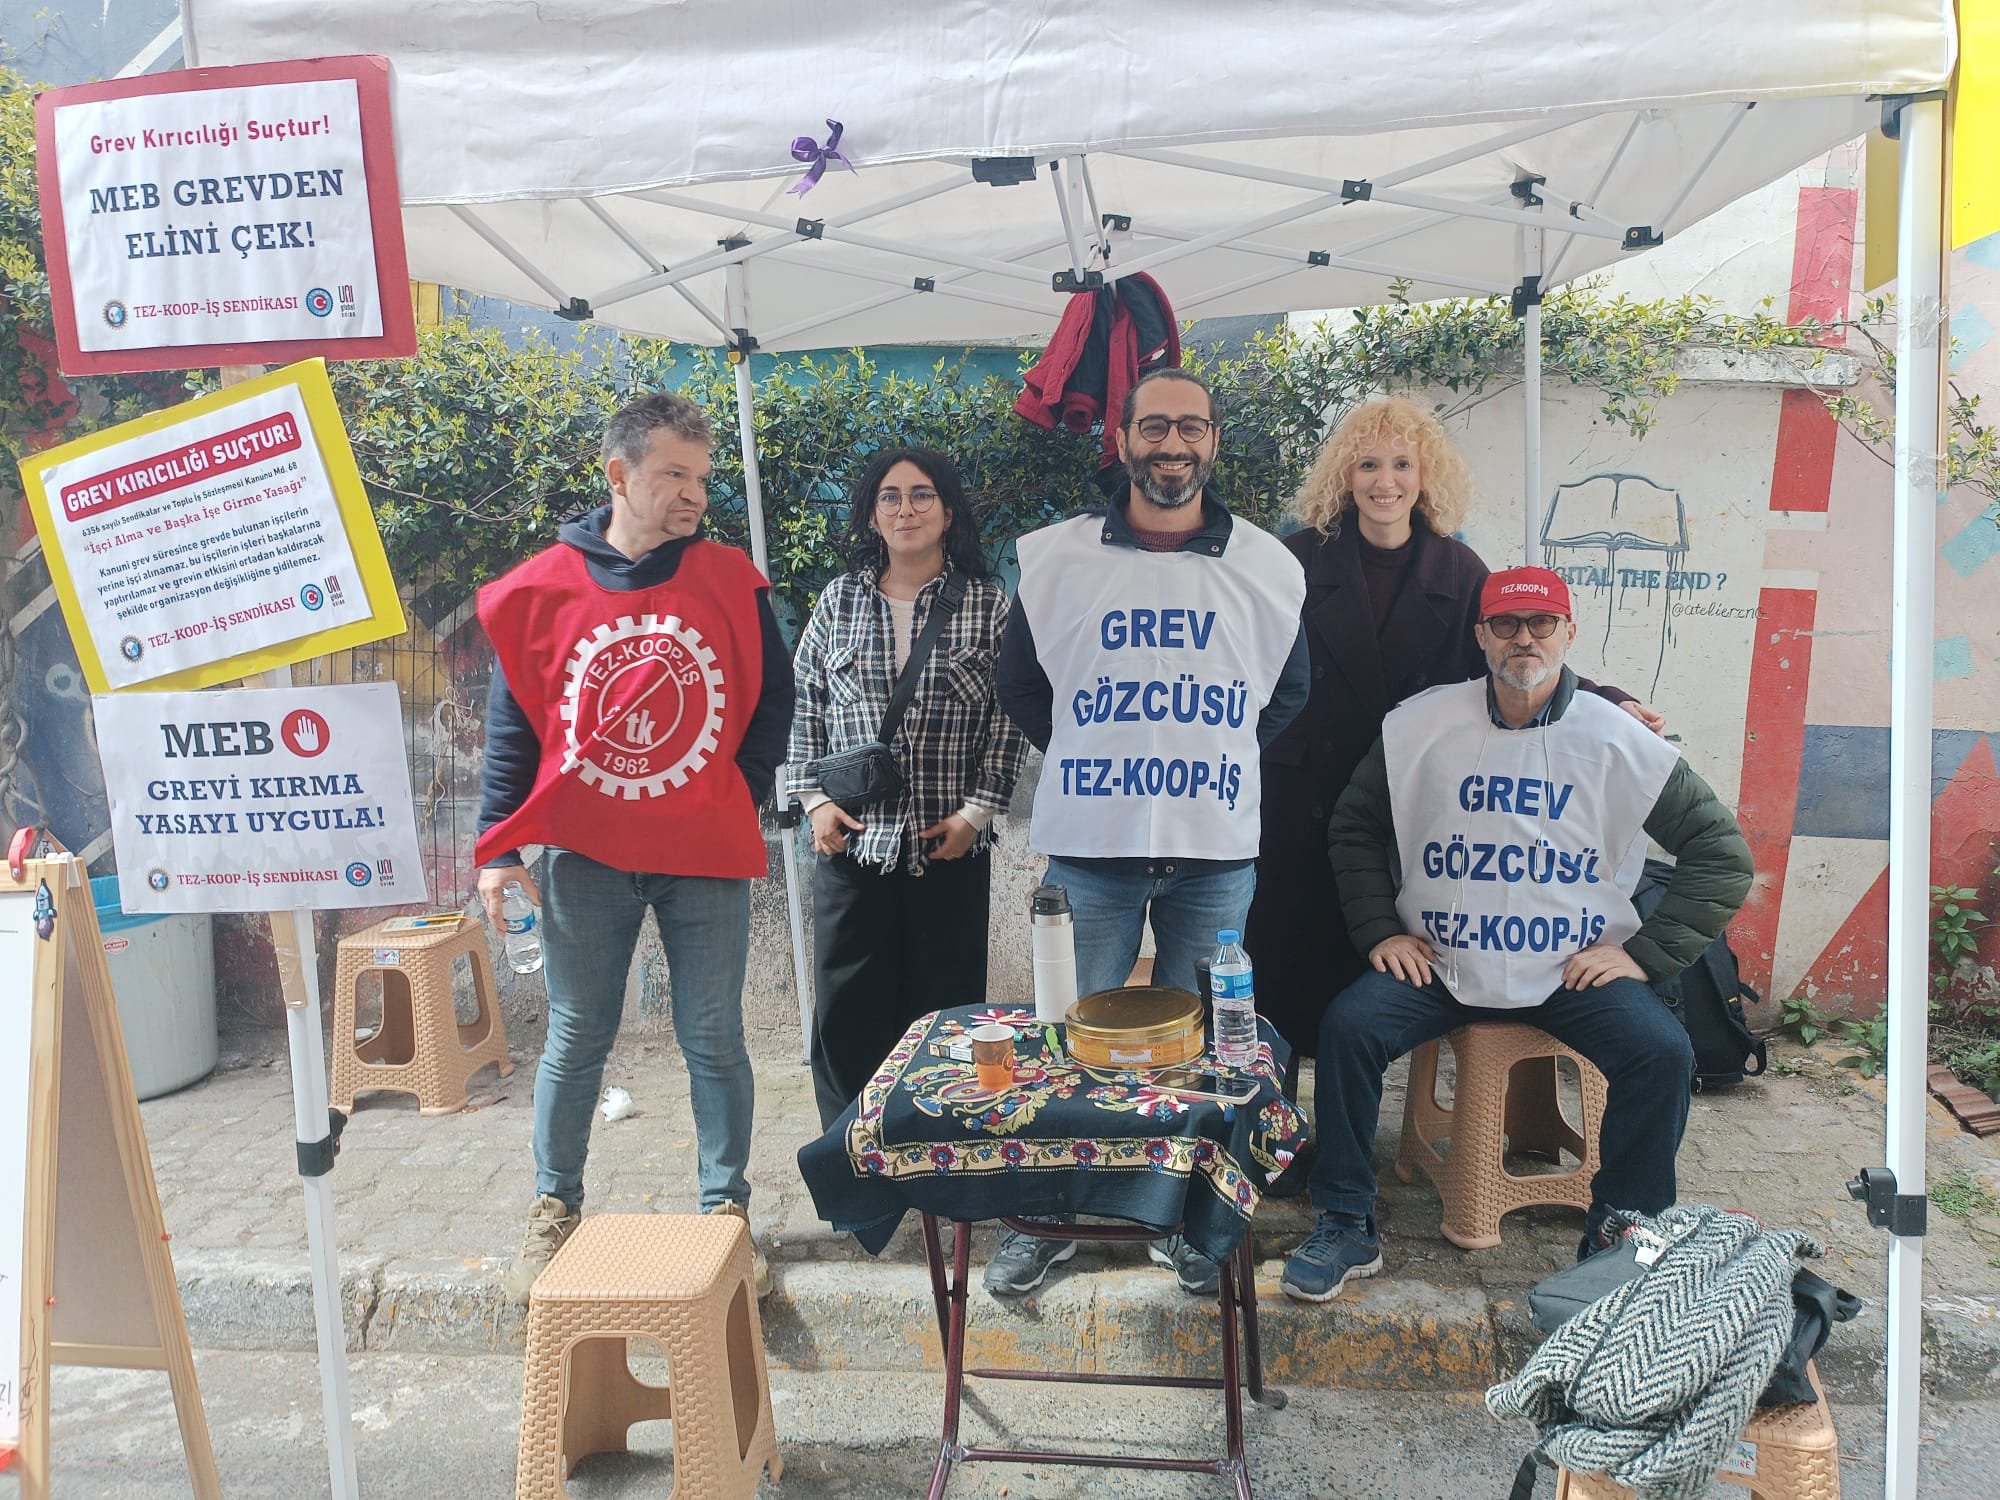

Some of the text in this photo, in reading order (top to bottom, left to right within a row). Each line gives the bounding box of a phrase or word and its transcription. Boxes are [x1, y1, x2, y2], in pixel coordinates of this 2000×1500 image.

[90, 115, 331, 154] Grev Kırıcılığı Suçtur!
[89, 168, 344, 215] MEB GREVDEN
[125, 221, 316, 260] ELİNİ ÇEK!
[133, 297, 221, 318] TEZ-KOOP-İŞ
[223, 294, 299, 313] SENDİKASI
[67, 421, 294, 512] GREV KIRICILIĞI SUÇTUR!
[82, 524, 101, 537] 6356
[101, 518, 121, 532] sayılı
[121, 507, 161, 524] Sendikalar
[162, 503, 172, 512] ve
[171, 496, 193, 509] Toplu
[202, 481, 244, 499] Sözleşmesi
[244, 471, 273, 486] Kanunu
[288, 461, 298, 471] 68
[115, 530, 144, 546] Alma
[146, 525, 162, 537] ve
[164, 512, 201, 532] Başka
[202, 505, 221, 519] İşe
[223, 492, 262, 512] Girme
[97, 579, 126, 596] yerine
[126, 572, 142, 586] işçi
[188, 556, 201, 566] bu
[202, 544, 240, 562] işçilerin
[240, 535, 266, 552] işleri
[267, 520, 321, 543] başkalarına
[99, 506, 309, 578] Kanuni grev süresince grevde bulunan işçilerin
[103, 534, 325, 609] yaptırılamaz ve grevin etkisini ortadan kaldıracak
[116, 554, 321, 621] şekilde organizasyon değişikliğine gidilemez.
[1617, 569, 1661, 589] THE
[1665, 571, 1711, 591] END
[1716, 572, 1728, 591] ?
[148, 616, 228, 649] TEZ-KOOP-İŞ
[228, 597, 296, 626] SENDİKASI
[1101, 608, 1217, 651] GREV
[582, 638, 701, 692] TEZ-KOOP-İŞ
[1072, 673, 1248, 729] GÖZCÜSÜ
[160, 721, 274, 758] MEB
[602, 751, 651, 775] 1962
[148, 774, 364, 801] GREVİ KIRMA
[1060, 753, 1242, 811] TEZ-KOOP-İŞ
[1459, 775, 1574, 820] GREV
[135, 806, 386, 834] YASAYI UYGULA!
[176, 869, 261, 887] TEZ-KOOP-İŞ
[263, 868, 339, 883] SENDİKASI
[1423, 834, 1600, 884] GÖZCÜSÜ
